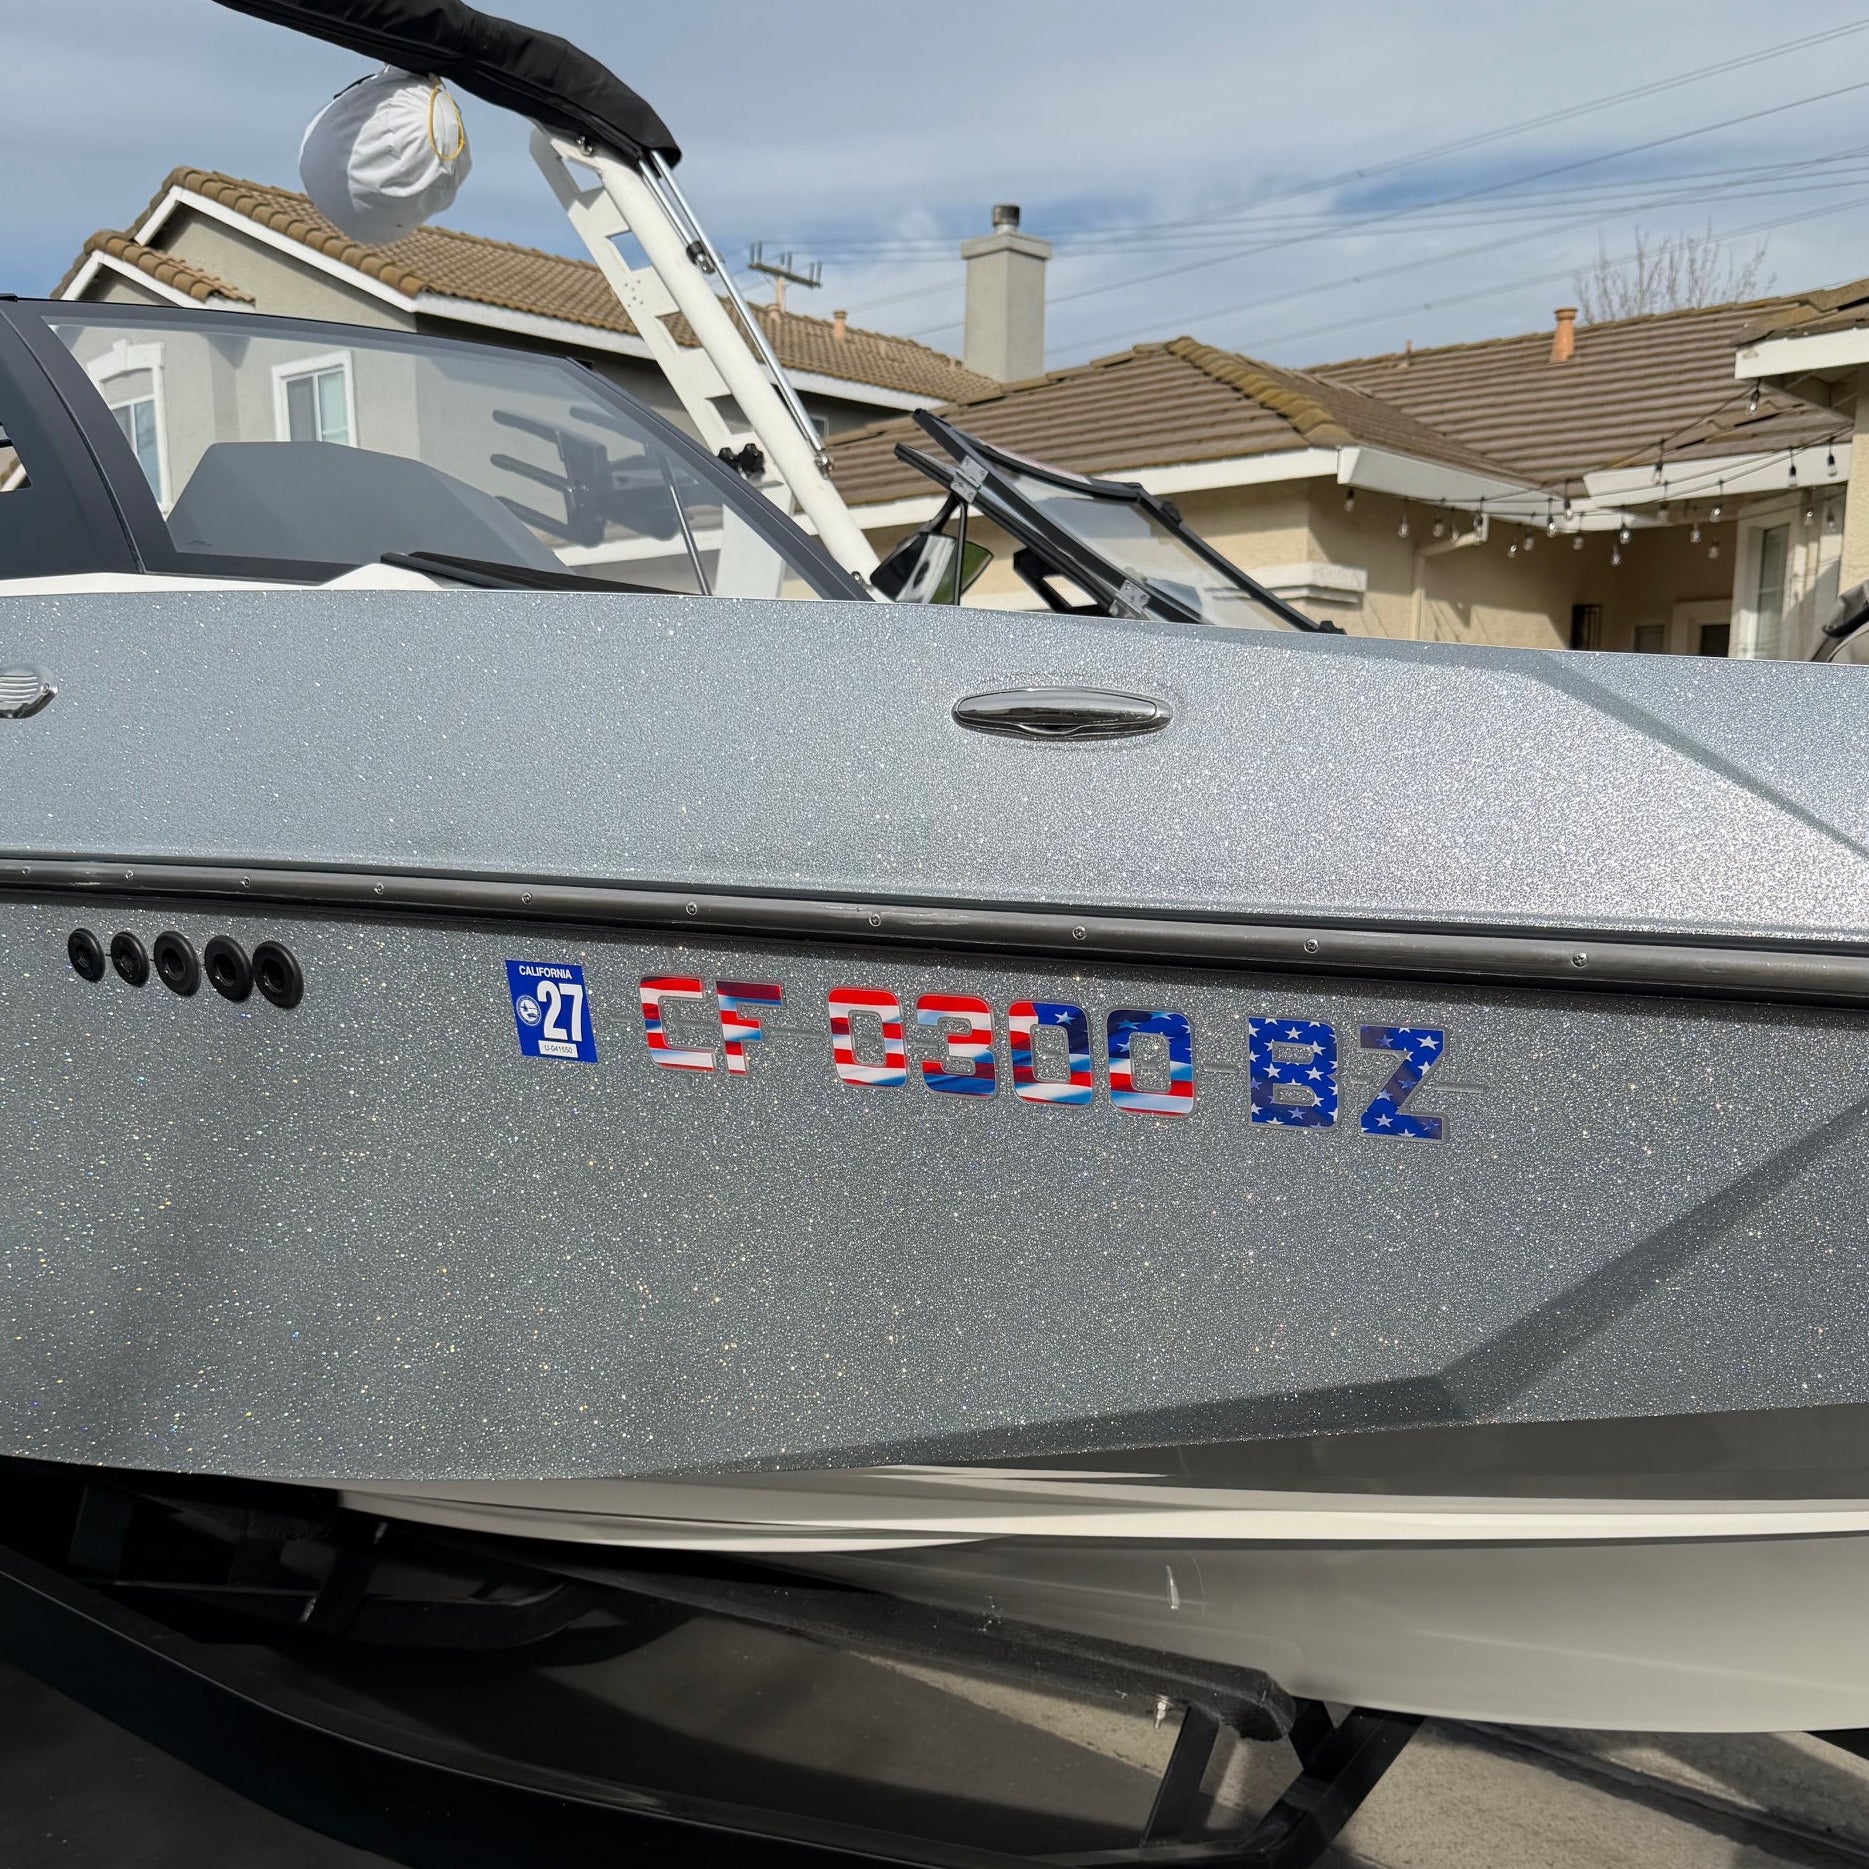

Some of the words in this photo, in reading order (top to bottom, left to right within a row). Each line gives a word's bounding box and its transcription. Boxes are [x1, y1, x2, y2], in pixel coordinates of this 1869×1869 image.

[519, 965, 572, 979] CALIFORNIA
[537, 980, 583, 1042] 27
[639, 976, 783, 1075] CF
[828, 987, 1195, 1117] 0300
[1248, 1017, 1445, 1140] BZ
